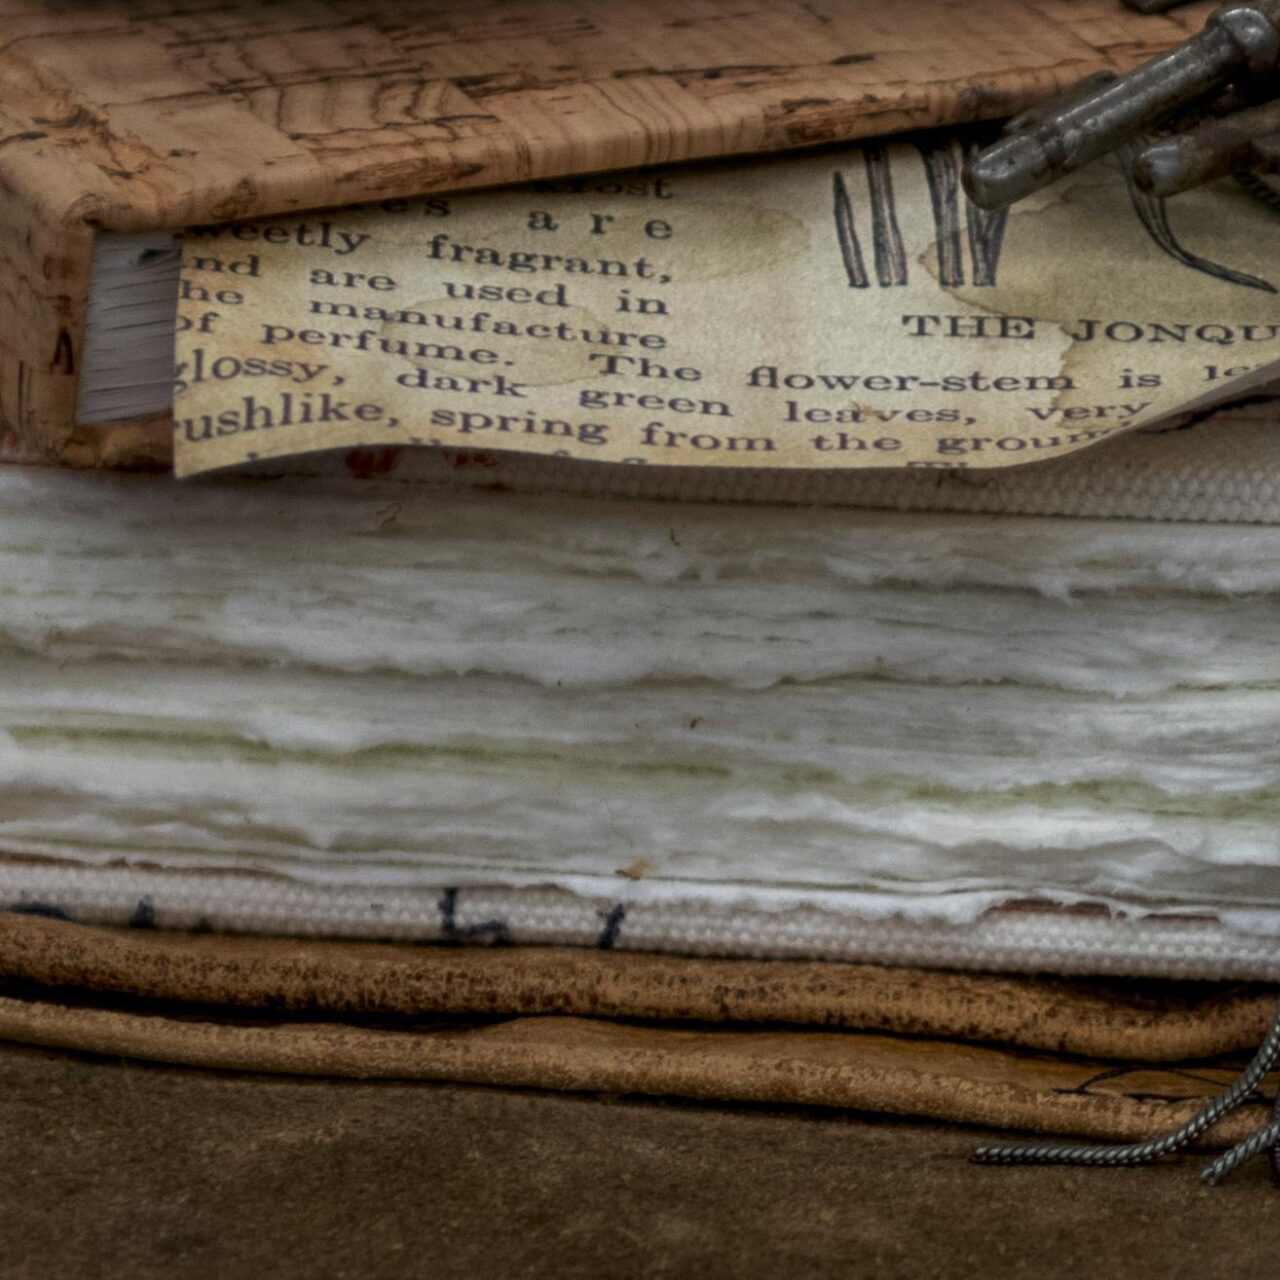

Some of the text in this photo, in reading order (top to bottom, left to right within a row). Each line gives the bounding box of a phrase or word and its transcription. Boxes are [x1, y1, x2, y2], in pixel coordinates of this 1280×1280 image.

[174, 221, 673, 284] weetly fragrant,
[181, 253, 669, 316] nd are used in
[309, 297, 668, 350] manufacture
[901, 314, 1036, 341] THE
[260, 321, 516, 367] perfume.
[588, 351, 701, 383] The
[746, 364, 1075, 393] flower-stem
[1117, 365, 1162, 389] is
[174, 391, 400, 444] ushlike,
[430, 405, 610, 447] spring
[639, 420, 776, 454] from
[811, 430, 901, 453] the
[396, 367, 527, 399] dark
[578, 386, 735, 419] green
[784, 399, 977, 427] leaves,
[1026, 396, 1152, 426] very
